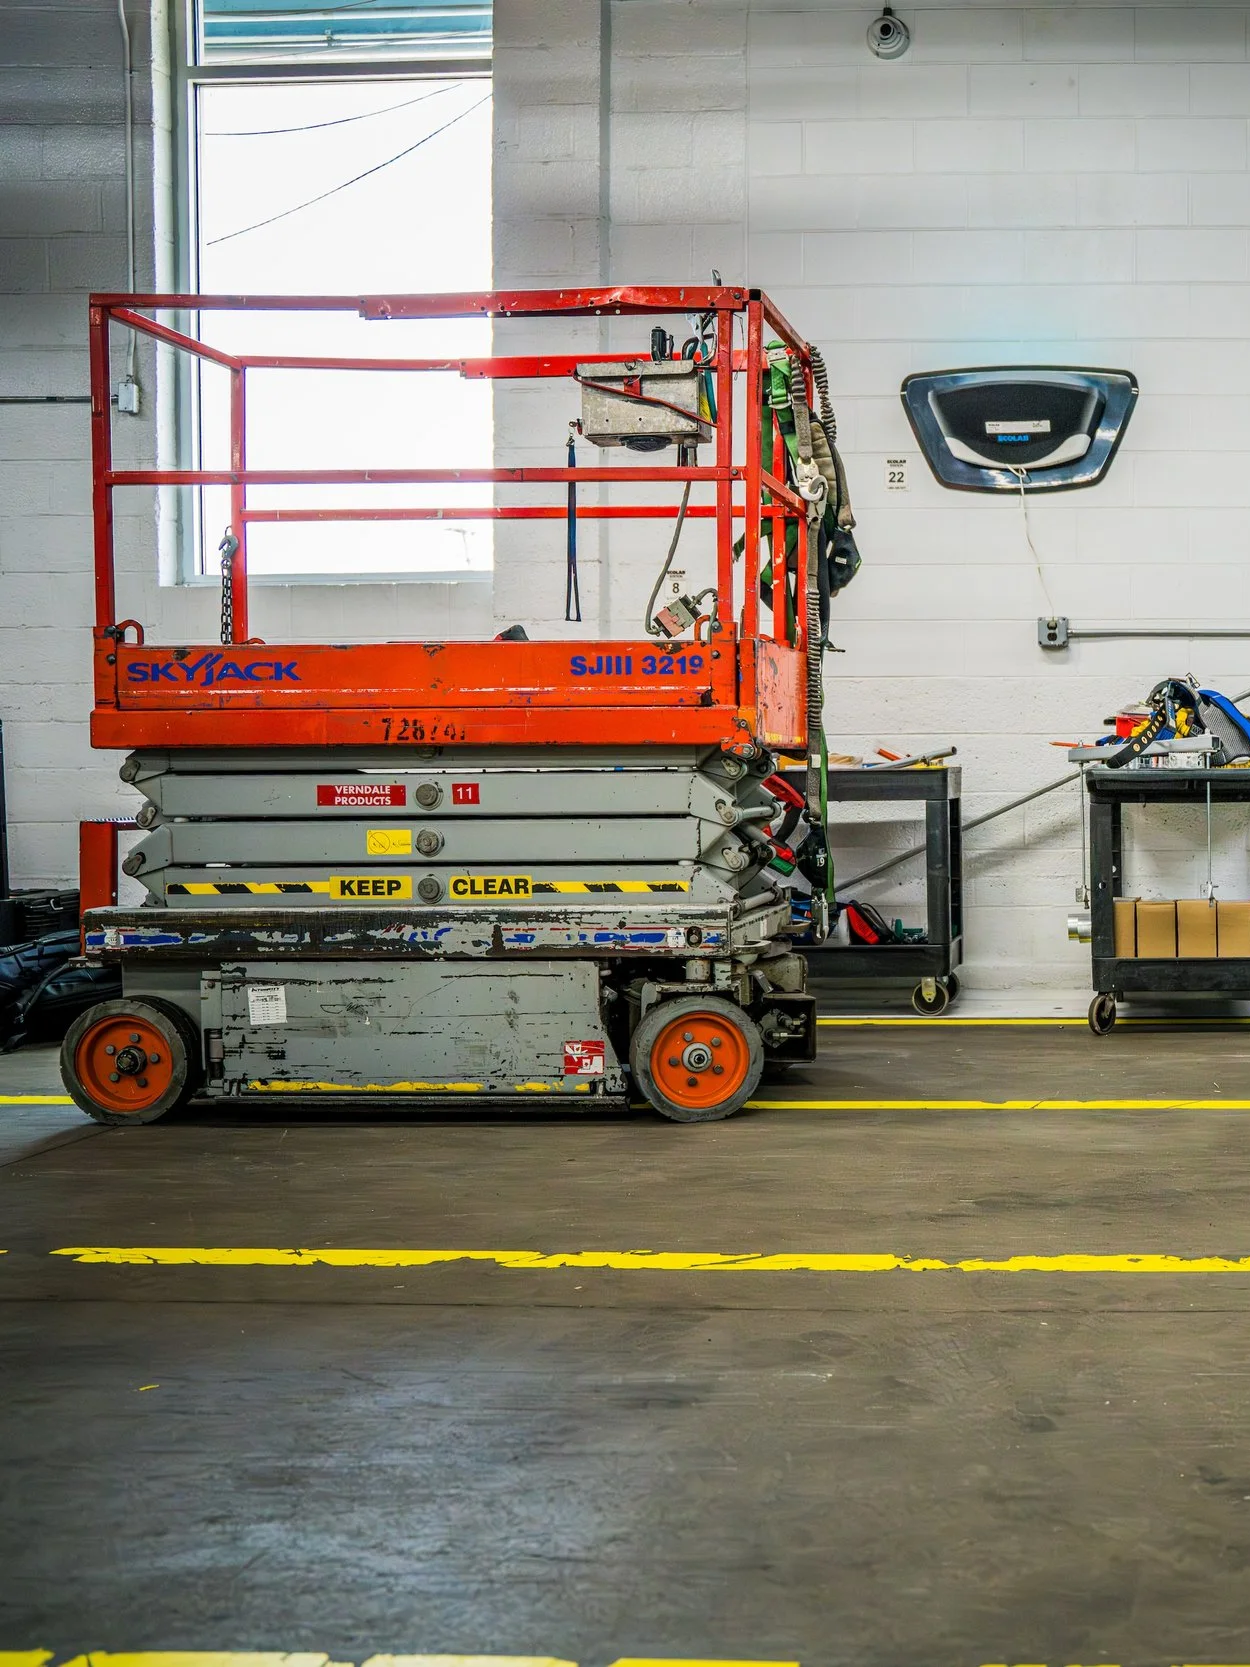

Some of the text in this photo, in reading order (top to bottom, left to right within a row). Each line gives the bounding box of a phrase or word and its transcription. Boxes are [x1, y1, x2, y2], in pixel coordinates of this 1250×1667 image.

[888, 471, 905, 483] 22
[672, 582, 680, 594] 8
[127, 653, 302, 687] SKYJACK
[642, 655, 705, 676] 3219
[334, 785, 391, 795] VERNDALE
[456, 786, 473, 800] 11
[334, 796, 391, 805] PRODUCTS
[340, 878, 530, 896] KEEP CLEAR
